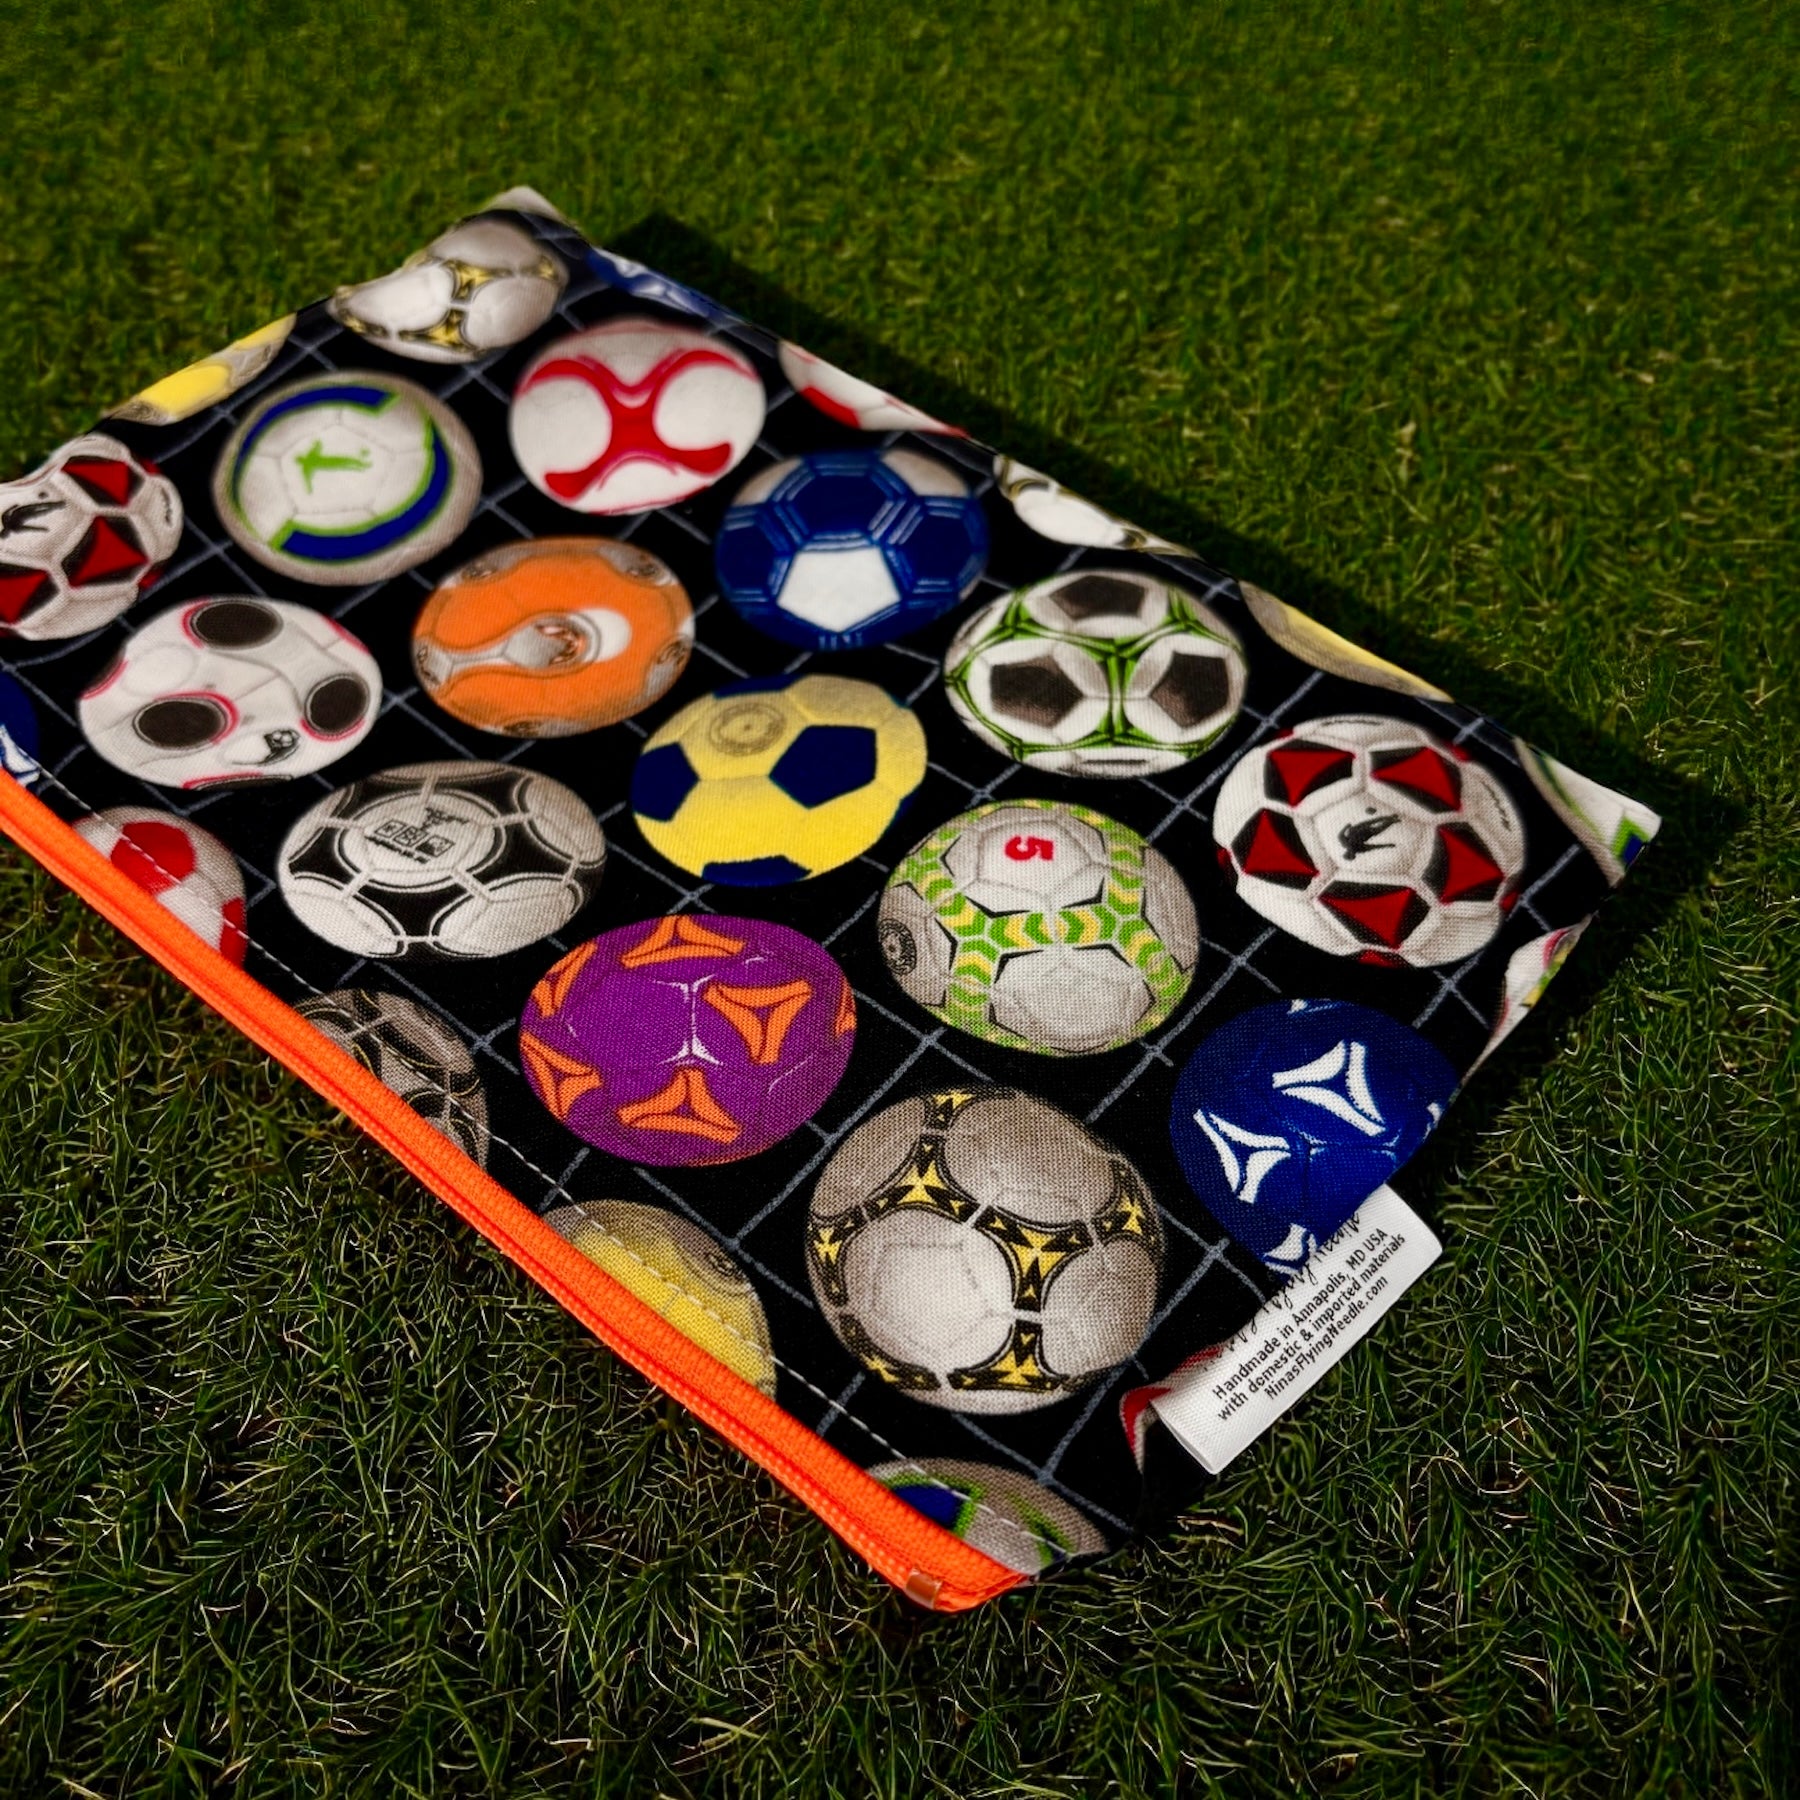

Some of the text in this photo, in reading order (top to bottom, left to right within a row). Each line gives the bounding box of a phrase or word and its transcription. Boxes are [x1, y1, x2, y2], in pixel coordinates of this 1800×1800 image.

[1005, 835, 1054, 861] 5
[1213, 1227, 1388, 1399] Handmade in Annapolis, MD USA
[1218, 1232, 1406, 1421] with domestic & imported materials
[1264, 1276, 1389, 1400] NinasFlyingNeedle.com
